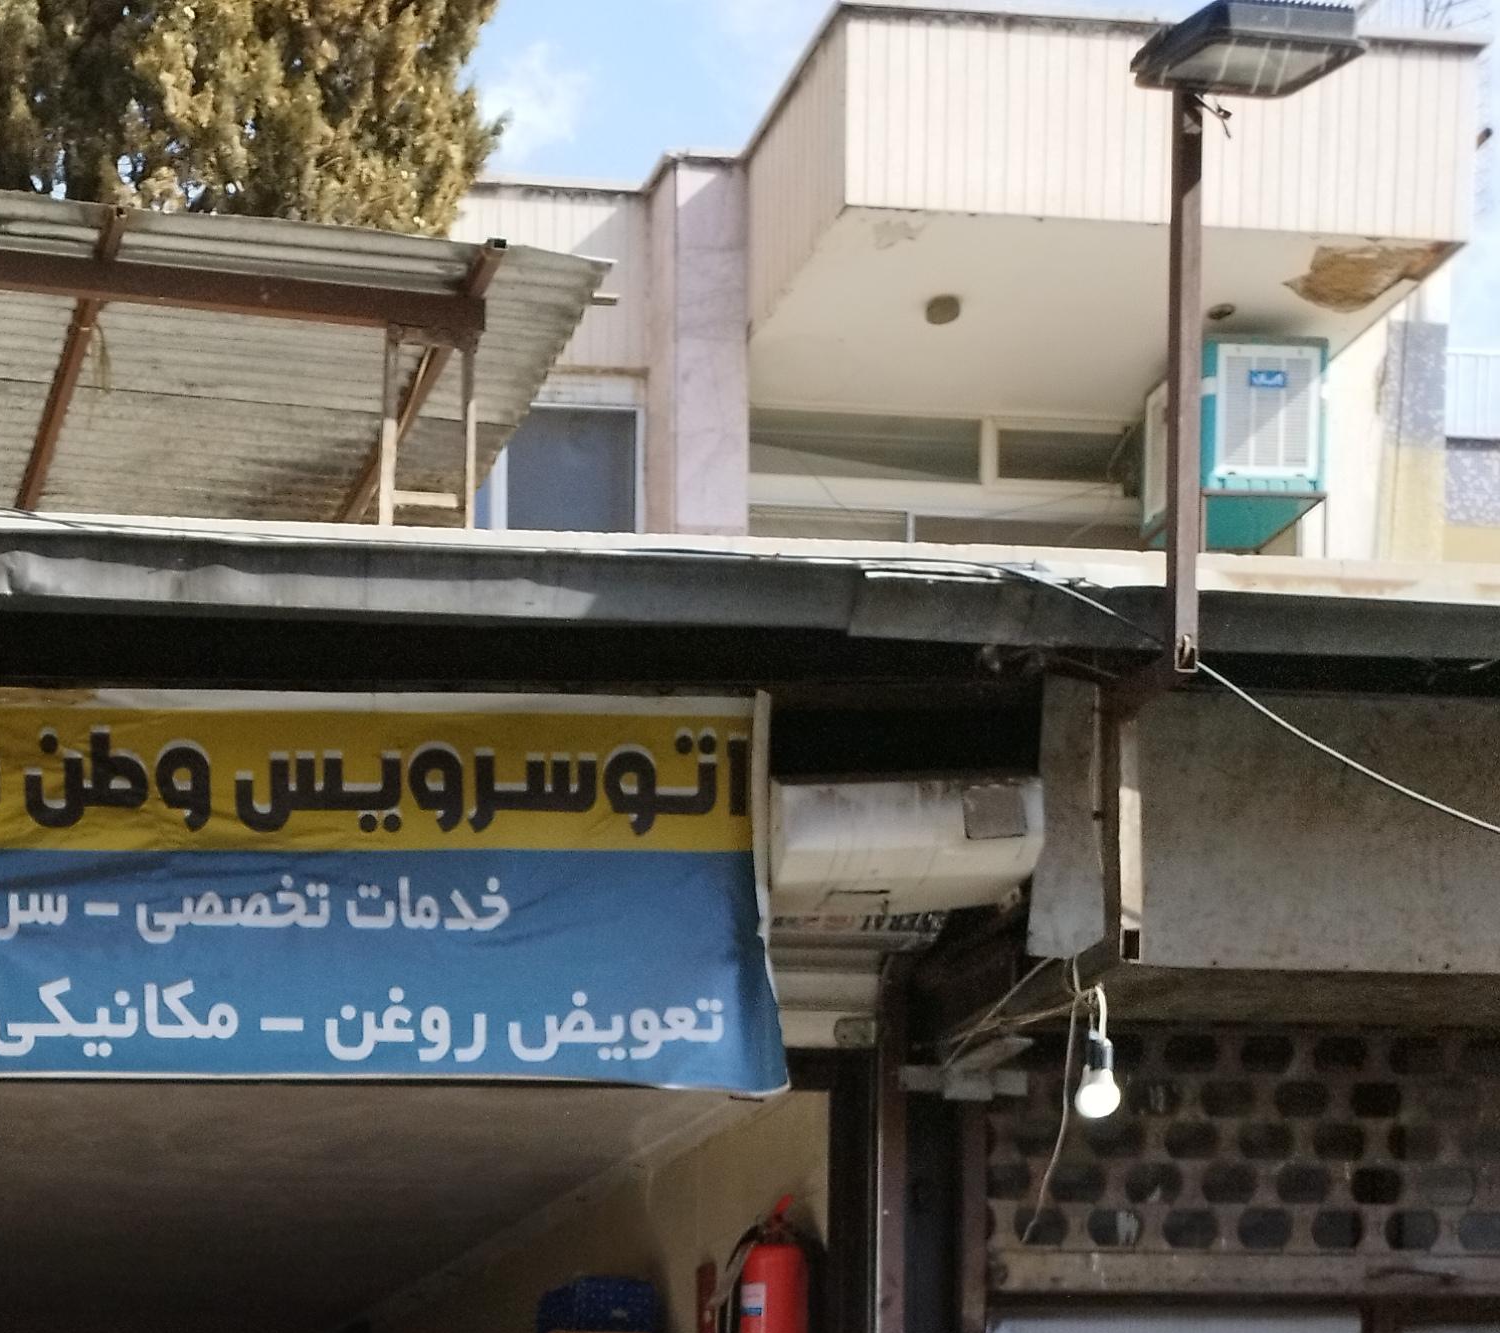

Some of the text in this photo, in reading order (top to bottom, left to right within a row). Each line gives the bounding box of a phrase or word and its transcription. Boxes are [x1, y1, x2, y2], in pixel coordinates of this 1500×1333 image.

[24, 725, 212, 833] وطن
[136, 874, 330, 944] تخصصی
[346, 875, 510, 931] خدمات
[324, 986, 488, 1064] روغن
[508, 990, 726, 1063] تعویض
